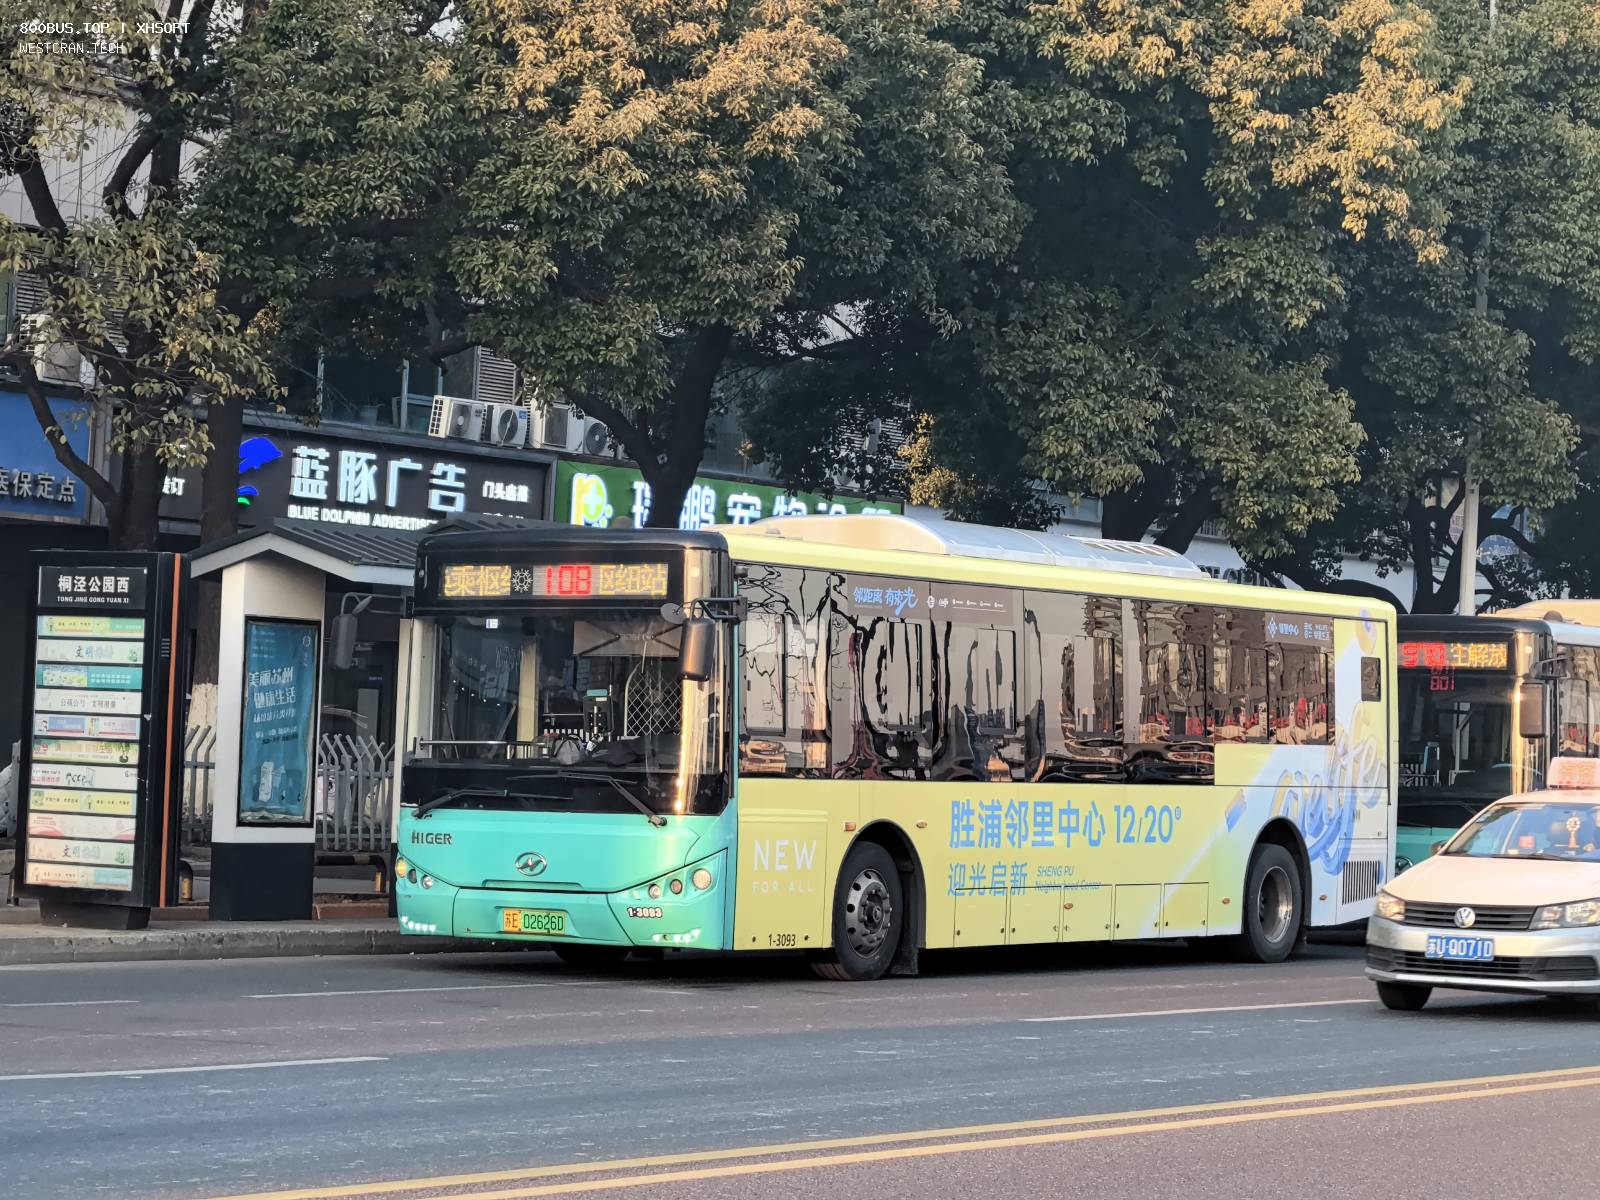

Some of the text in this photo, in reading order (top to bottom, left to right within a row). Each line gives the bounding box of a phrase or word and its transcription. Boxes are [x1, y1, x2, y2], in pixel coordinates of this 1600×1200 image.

[289, 445, 466, 513] 蓝豚广告
[287, 504, 319, 521] BLUE
[320, 508, 370, 526] DOLPHIN
[57, 575, 130, 593] 桐泾公园西
[545, 564, 592, 596] 108
[949, 799, 1106, 849] 胜浦邻里中心
[411, 831, 452, 845] HIGER
[754, 839, 817, 872] NEW
[947, 861, 1028, 898] 迎光启新
[1036, 865, 1075, 878] SHENG PU
[752, 881, 815, 894] FOR ALL
[768, 933, 796, 947] 1-3093
